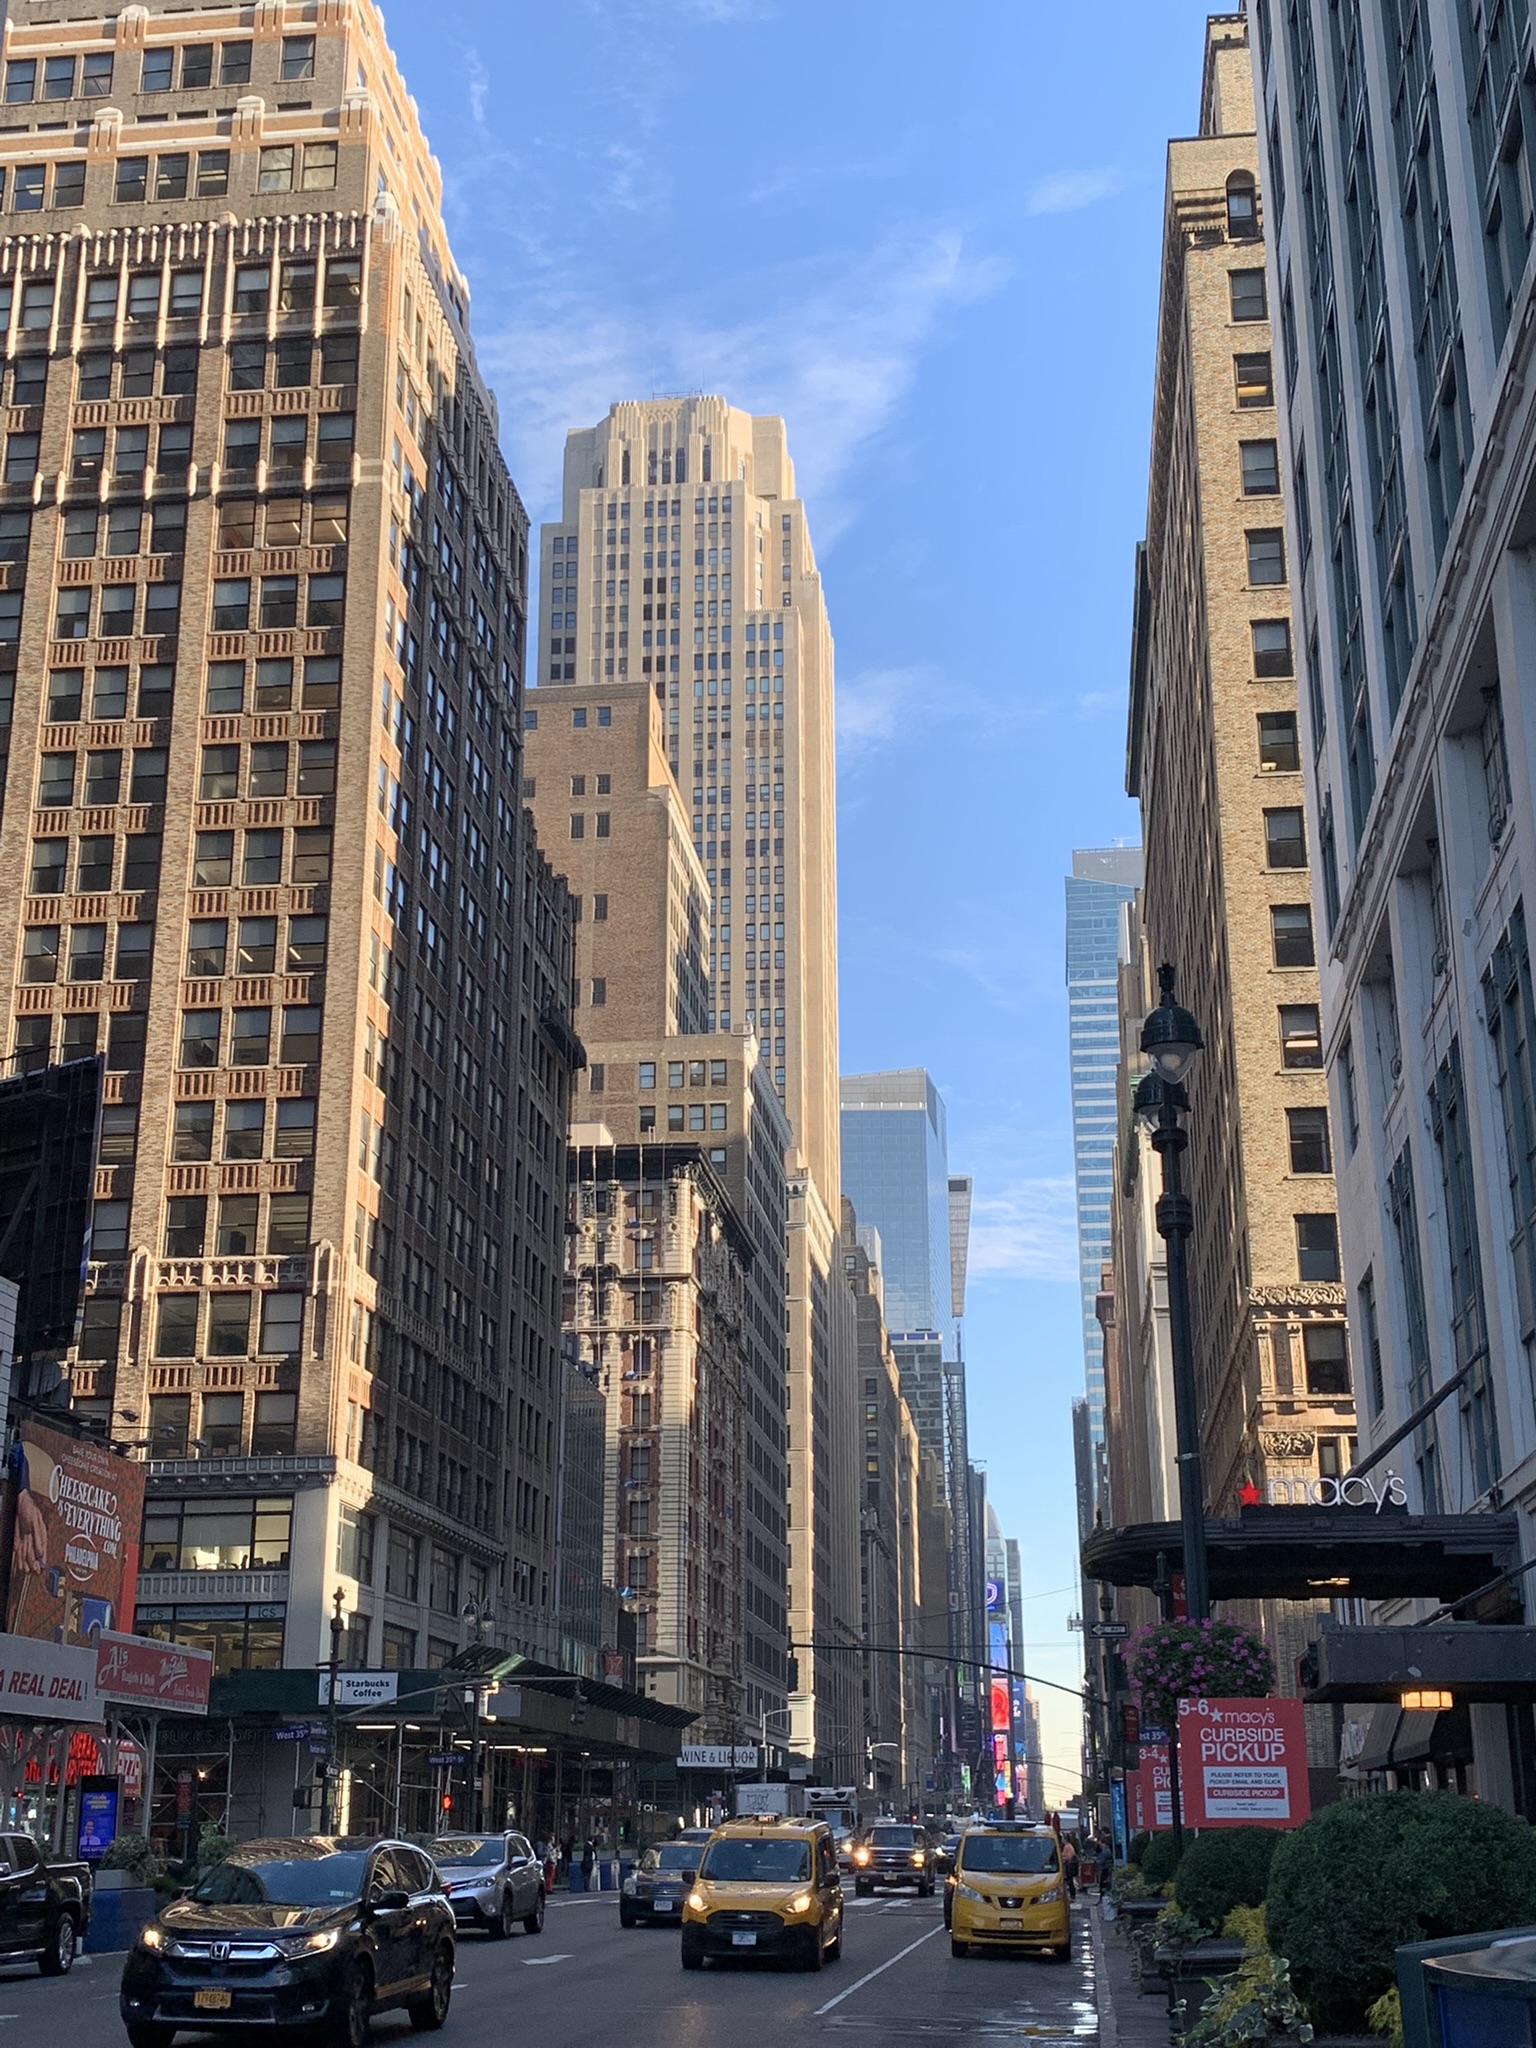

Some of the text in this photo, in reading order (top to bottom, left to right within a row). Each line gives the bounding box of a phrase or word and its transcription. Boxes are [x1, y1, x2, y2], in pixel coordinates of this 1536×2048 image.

[49, 1465, 117, 1516] CHEESECAKE
[64, 1503, 122, 1541] EVERYTHING
[8, 1670, 45, 1697] REAL
[48, 1676, 88, 1702] DEAL!
[345, 1679, 390, 1688] Starbucks
[353, 1689, 382, 1698] Coffee
[1179, 1699, 1209, 1716] 5-6
[276, 1731, 295, 1741] West
[1200, 1728, 1285, 1742] CURBSIDE
[682, 1750, 707, 1763] WINE
[709, 1752, 715, 1763] &
[1139, 1748, 1159, 1760] 3-4
[1201, 1743, 1286, 1762] PICKUP
[1213, 1789, 1280, 1797] CURBSIDE PICKUP
